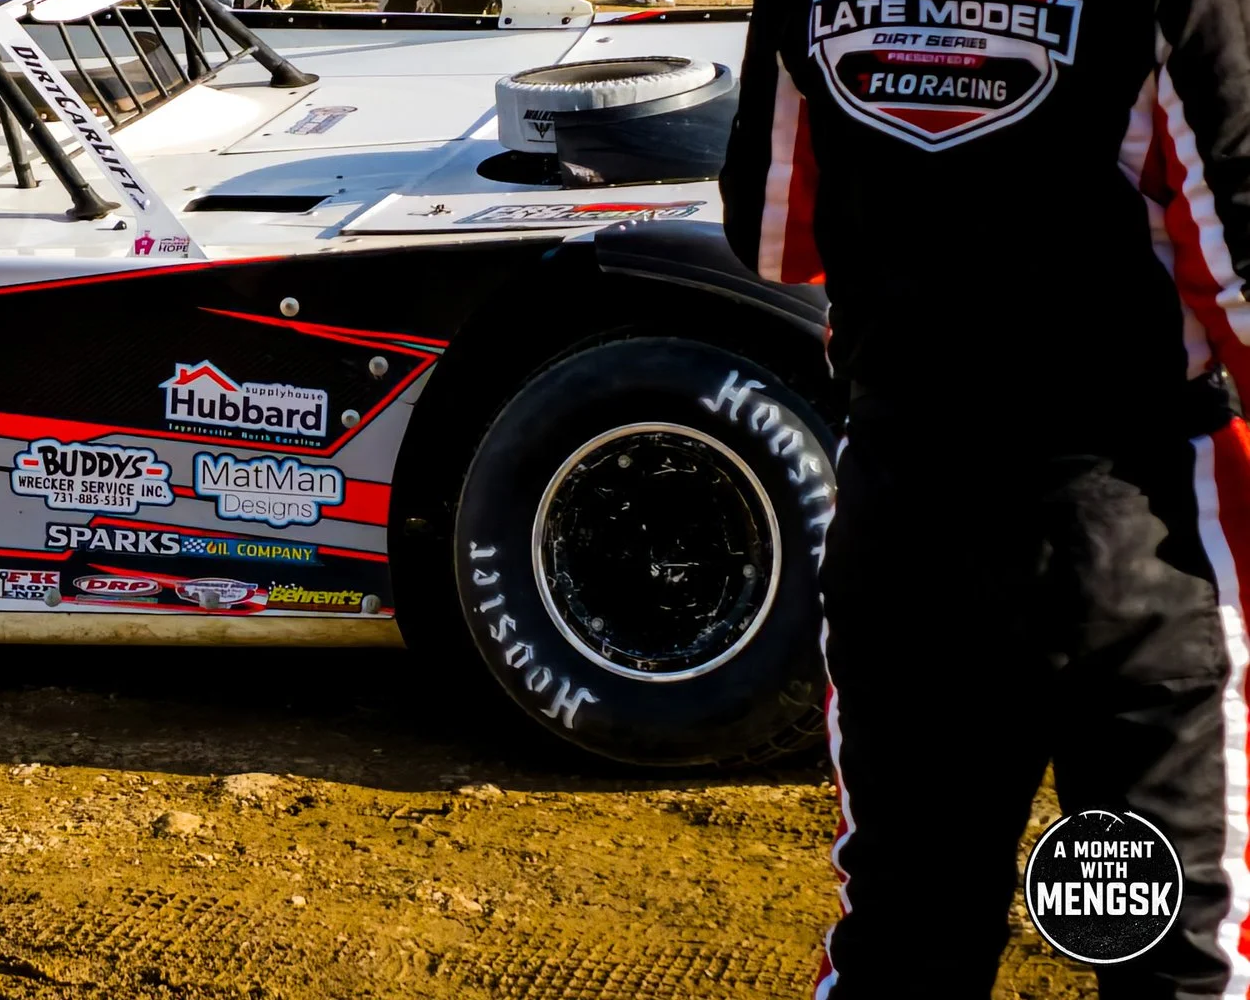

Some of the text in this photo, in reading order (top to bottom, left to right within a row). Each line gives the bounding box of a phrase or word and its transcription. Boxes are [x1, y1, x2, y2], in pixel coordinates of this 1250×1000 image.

[813, 0, 1061, 44] LATE MODEL
[871, 33, 987, 50] DIRT SERIES
[245, 386, 324, 401] supplyhouse
[170, 387, 323, 431] Hubbard
[37, 446, 148, 480] BUDDYS
[18, 475, 168, 499] WRECKER SERVICE INC.
[201, 459, 338, 495] MatMan
[53, 491, 132, 507] 731-885-5331
[224, 494, 313, 520] Designs
[47, 525, 313, 561] SPARKS OIL COMPANY
[3, 590, 46, 600] END
[86, 579, 150, 591] DRP
